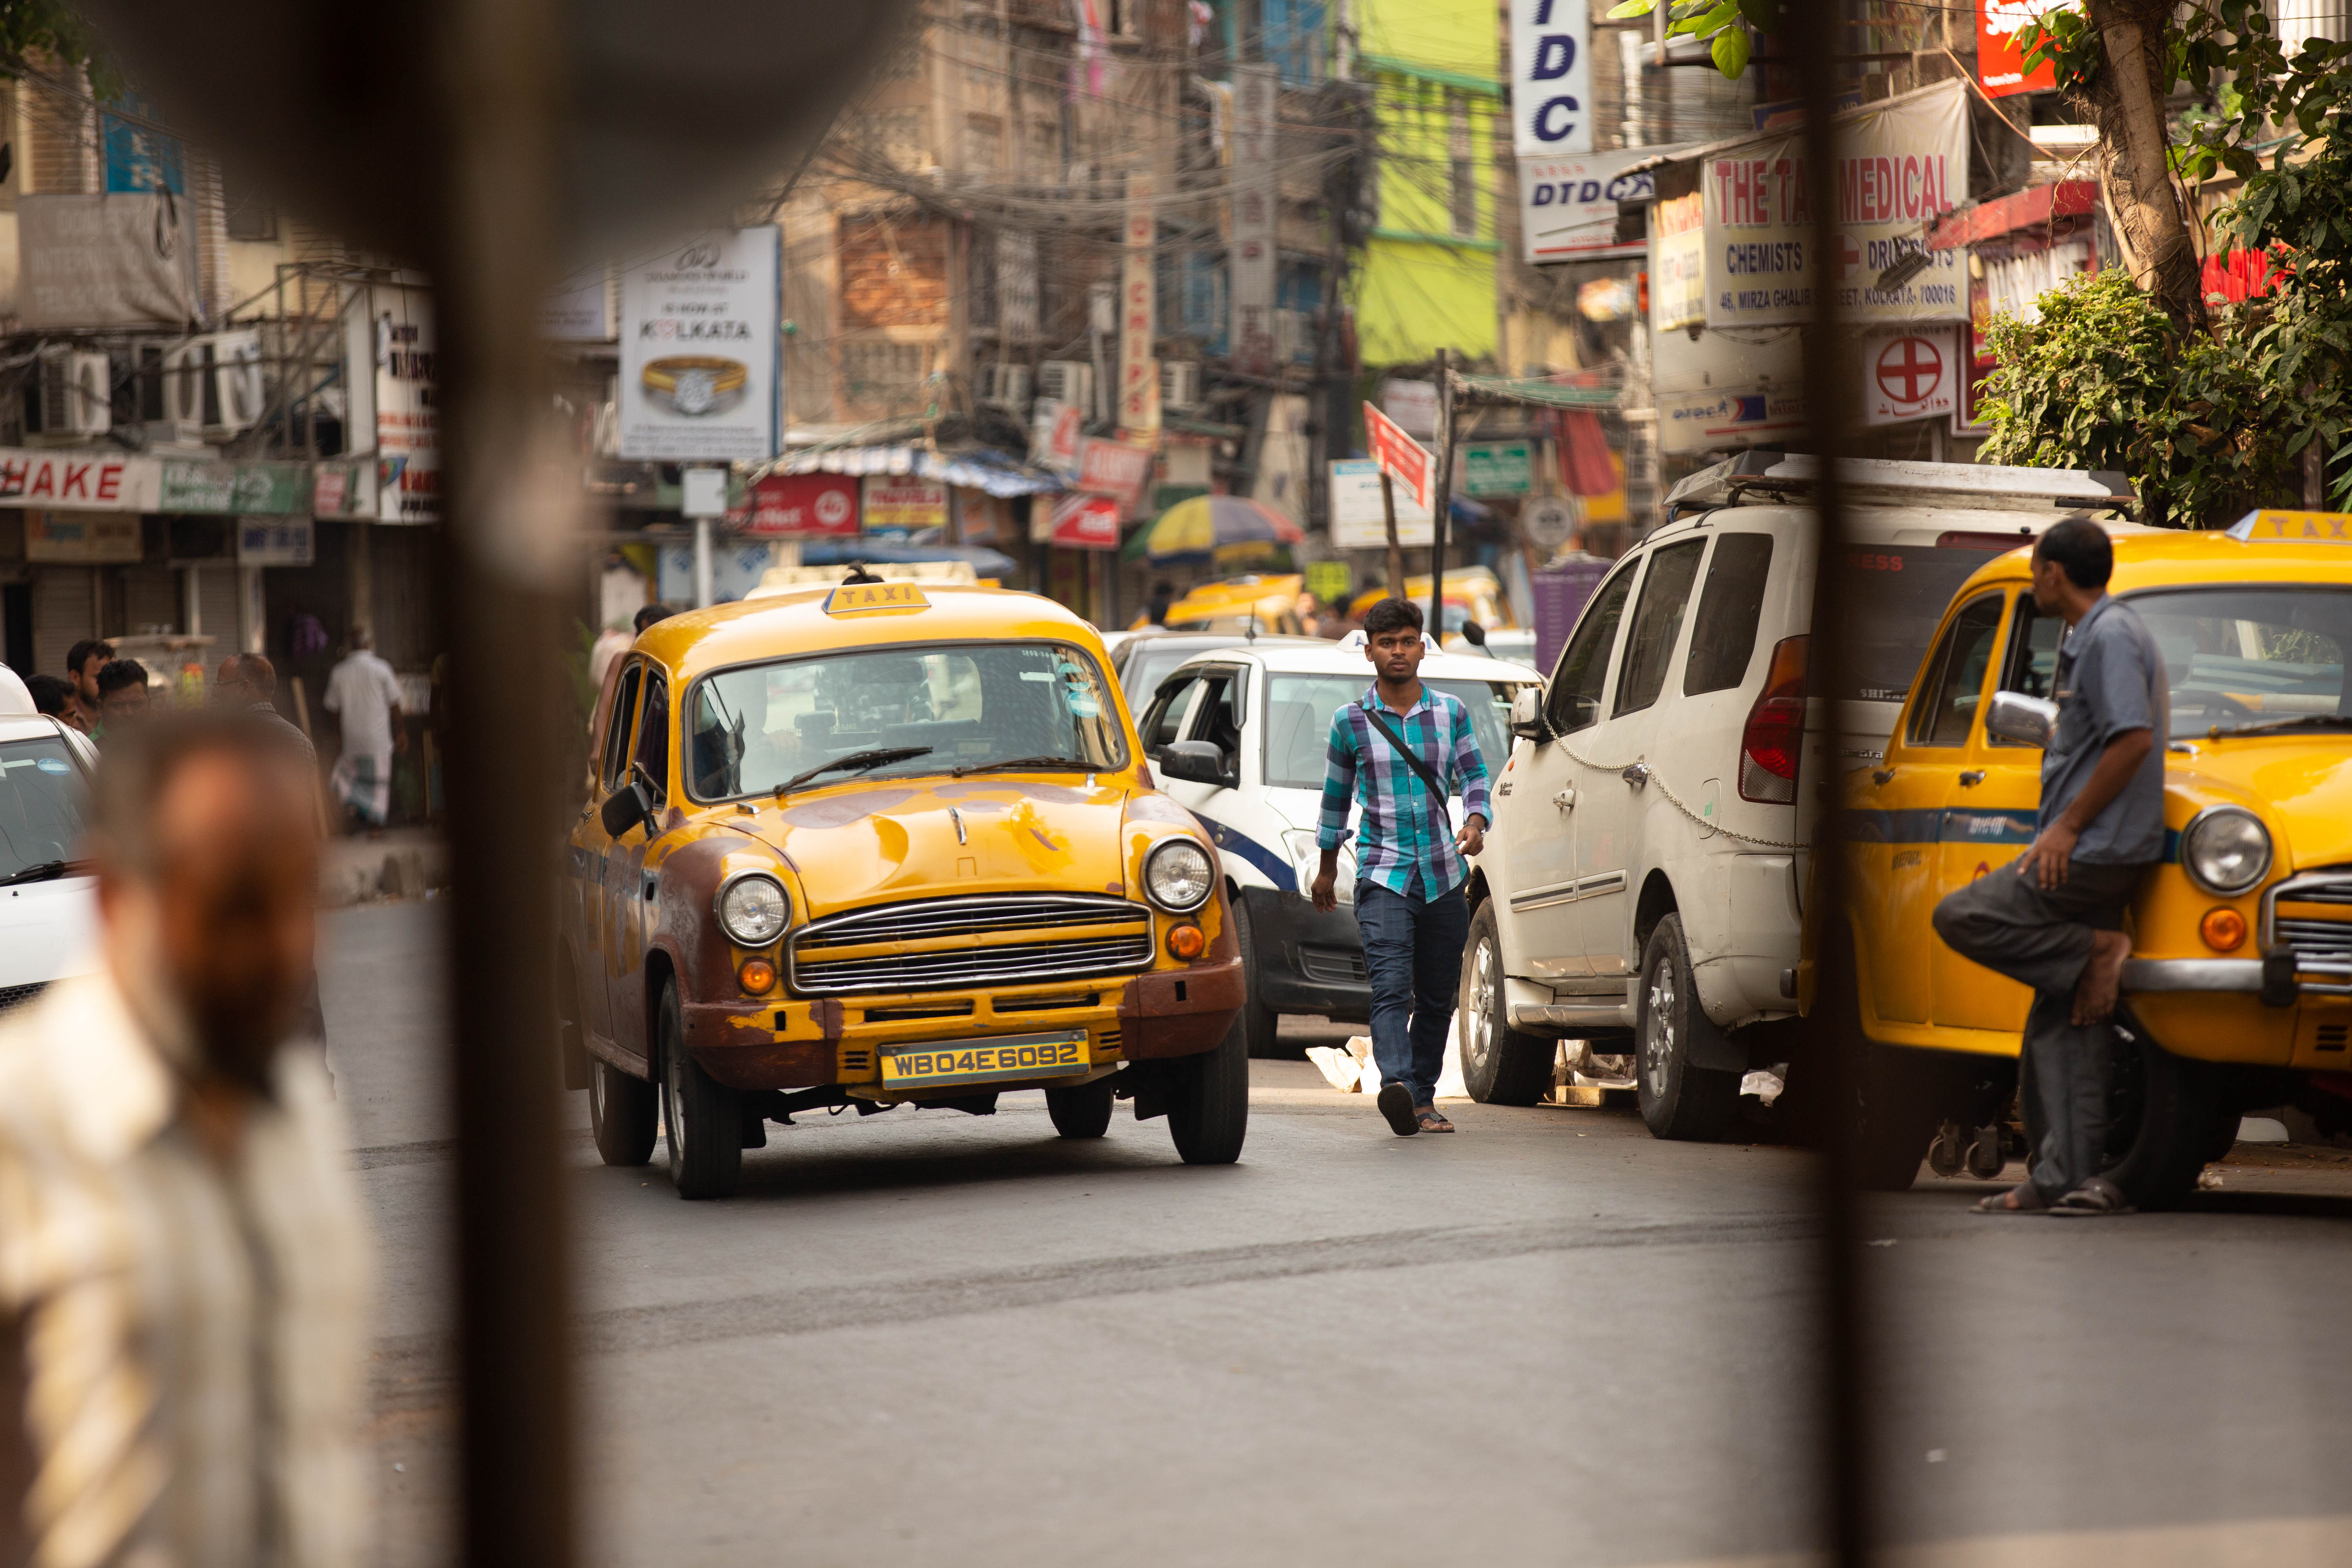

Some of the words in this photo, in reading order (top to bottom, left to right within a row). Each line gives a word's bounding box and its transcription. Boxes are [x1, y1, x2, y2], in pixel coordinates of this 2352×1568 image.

[1531, 177, 1627, 205] DTDC
[1715, 160, 1768, 225] THE
[1775, 157, 1812, 225] TA
[1838, 154, 1953, 223] MEDICAL
[1726, 242, 1803, 275] CHEMISTS
[1738, 290, 1771, 310] MIRZA
[1773, 288, 1811, 307] GHALIB
[1814, 287, 1862, 309] SEET,
[1919, 284, 1956, 305] 700016
[1, 458, 125, 501] HAKE
[2268, 515, 2348, 537] TAX
[1846, 553, 1904, 572] RESS
[842, 587, 911, 604] TAXI
[894, 1043, 1078, 1076] WB04E6092
